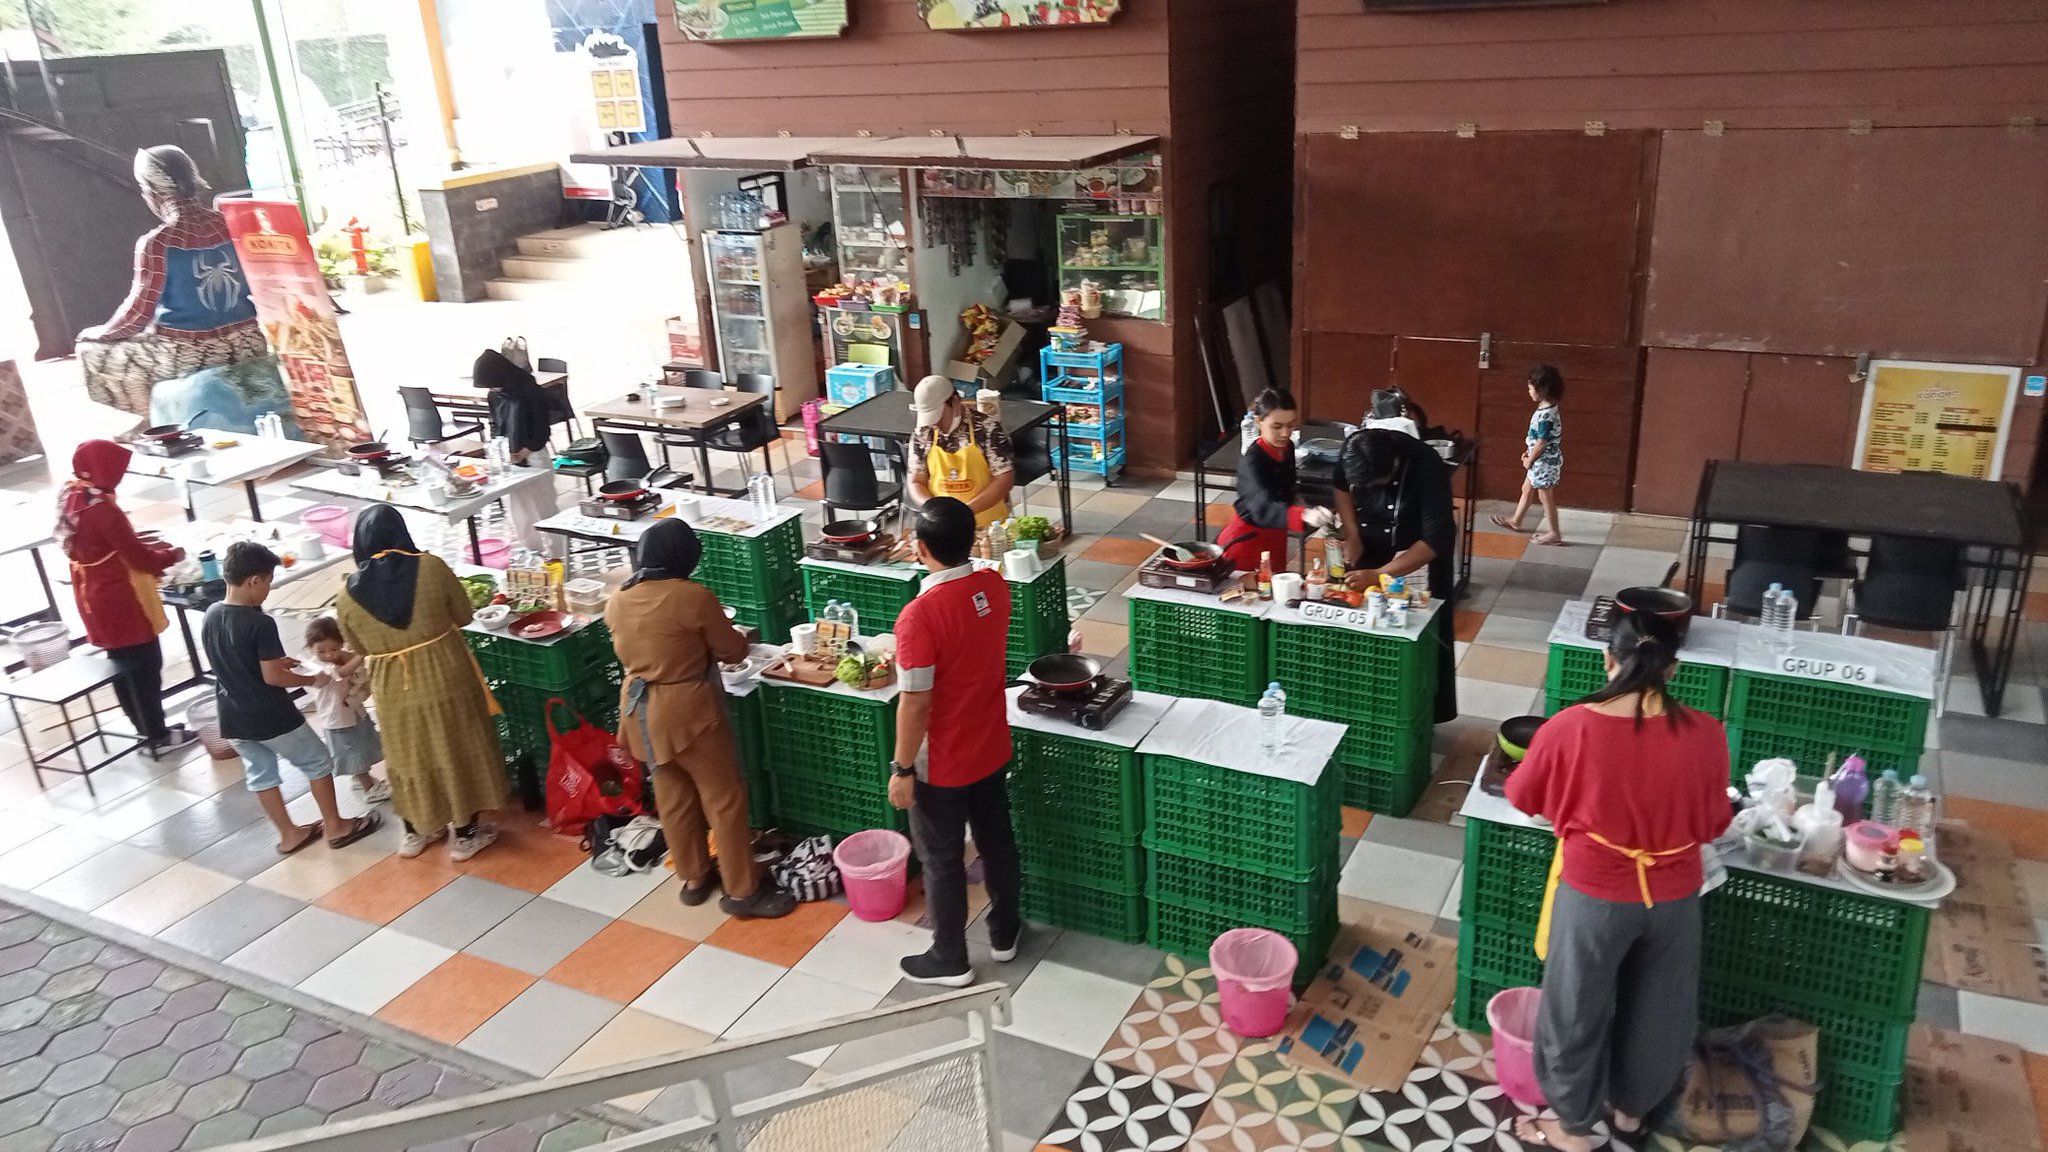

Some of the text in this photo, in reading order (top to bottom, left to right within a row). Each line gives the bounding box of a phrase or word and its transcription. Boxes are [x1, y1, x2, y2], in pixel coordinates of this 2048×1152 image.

[1304, 604, 1368, 625] GRUP 05
[1783, 658, 1867, 681] GRUP 06
